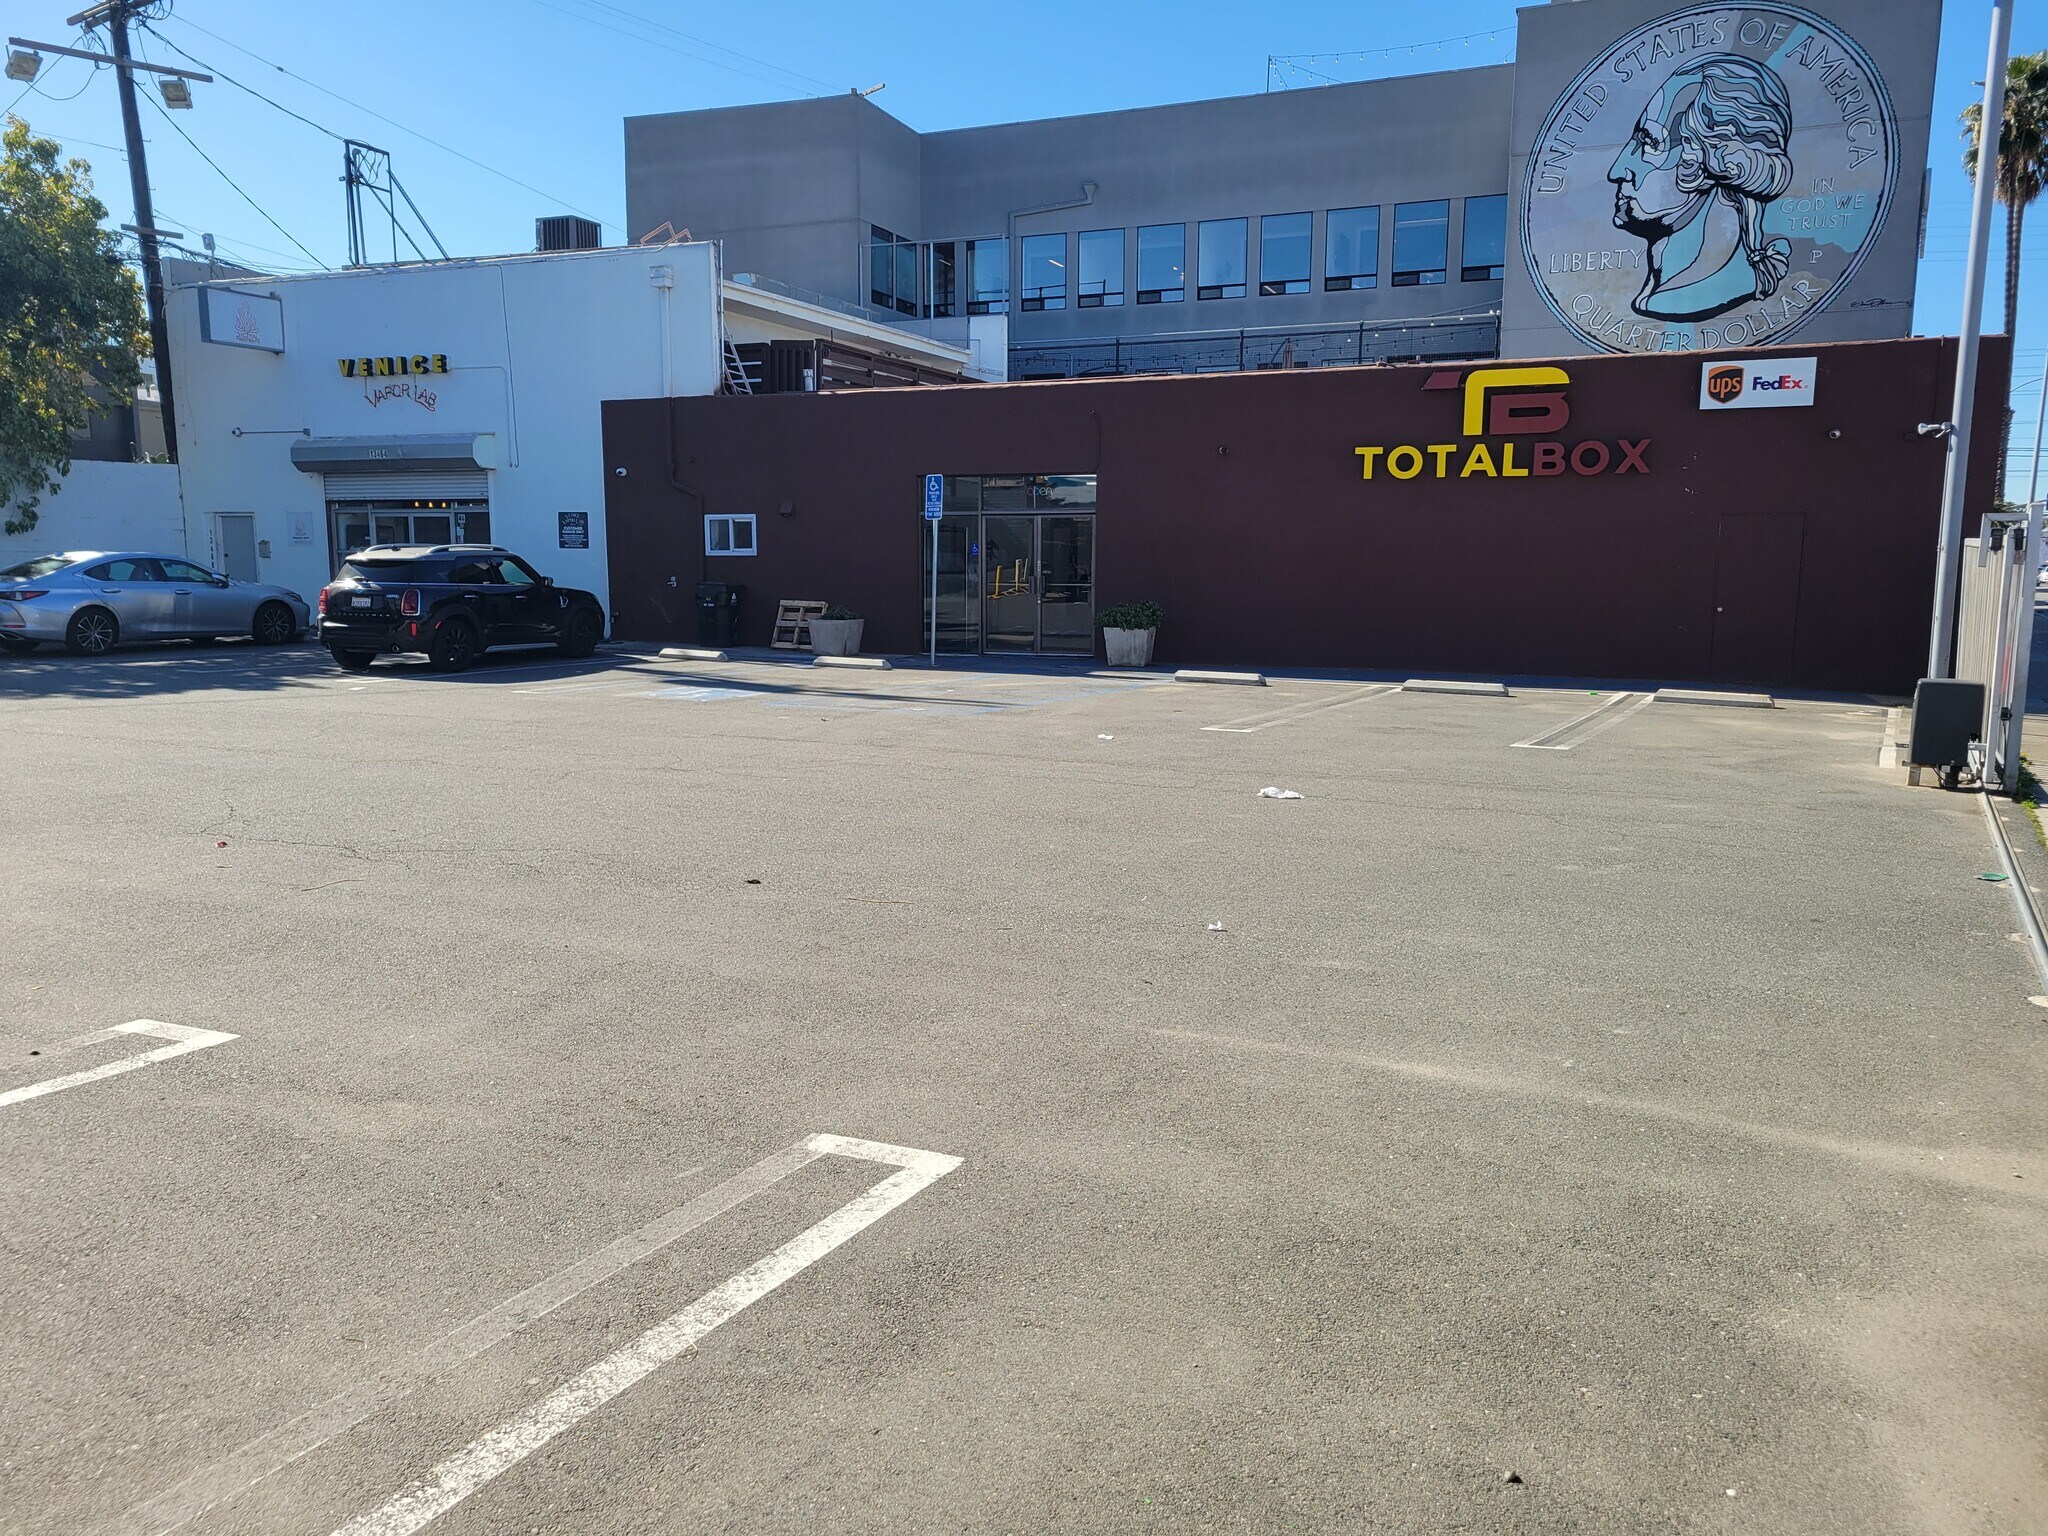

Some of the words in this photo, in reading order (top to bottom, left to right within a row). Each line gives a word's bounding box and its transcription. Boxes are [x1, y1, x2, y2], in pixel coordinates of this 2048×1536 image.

[1537, 82, 1609, 195] UNITED
[1613, 16, 1729, 84] STATES
[1738, 17, 1791, 50] OF
[1785, 34, 1878, 171] AMERICA
[1811, 177, 1836, 194] IN
[1779, 195, 1825, 213] GOD
[1833, 193, 1865, 210] WE
[1788, 212, 1854, 231] TRUST
[1548, 248, 1645, 276] LIBERTY
[1808, 250, 1823, 265] P
[1571, 293, 1692, 353] QUARTER
[1699, 279, 1821, 350] DOLLAR
[337, 353, 448, 378] VENICE
[364, 383, 413, 408] VAPOR
[414, 385, 437, 412] LAB
[1708, 375, 1744, 398] ups
[1751, 374, 1804, 391] FedEx
[1354, 438, 1653, 480] TOTALBOX
